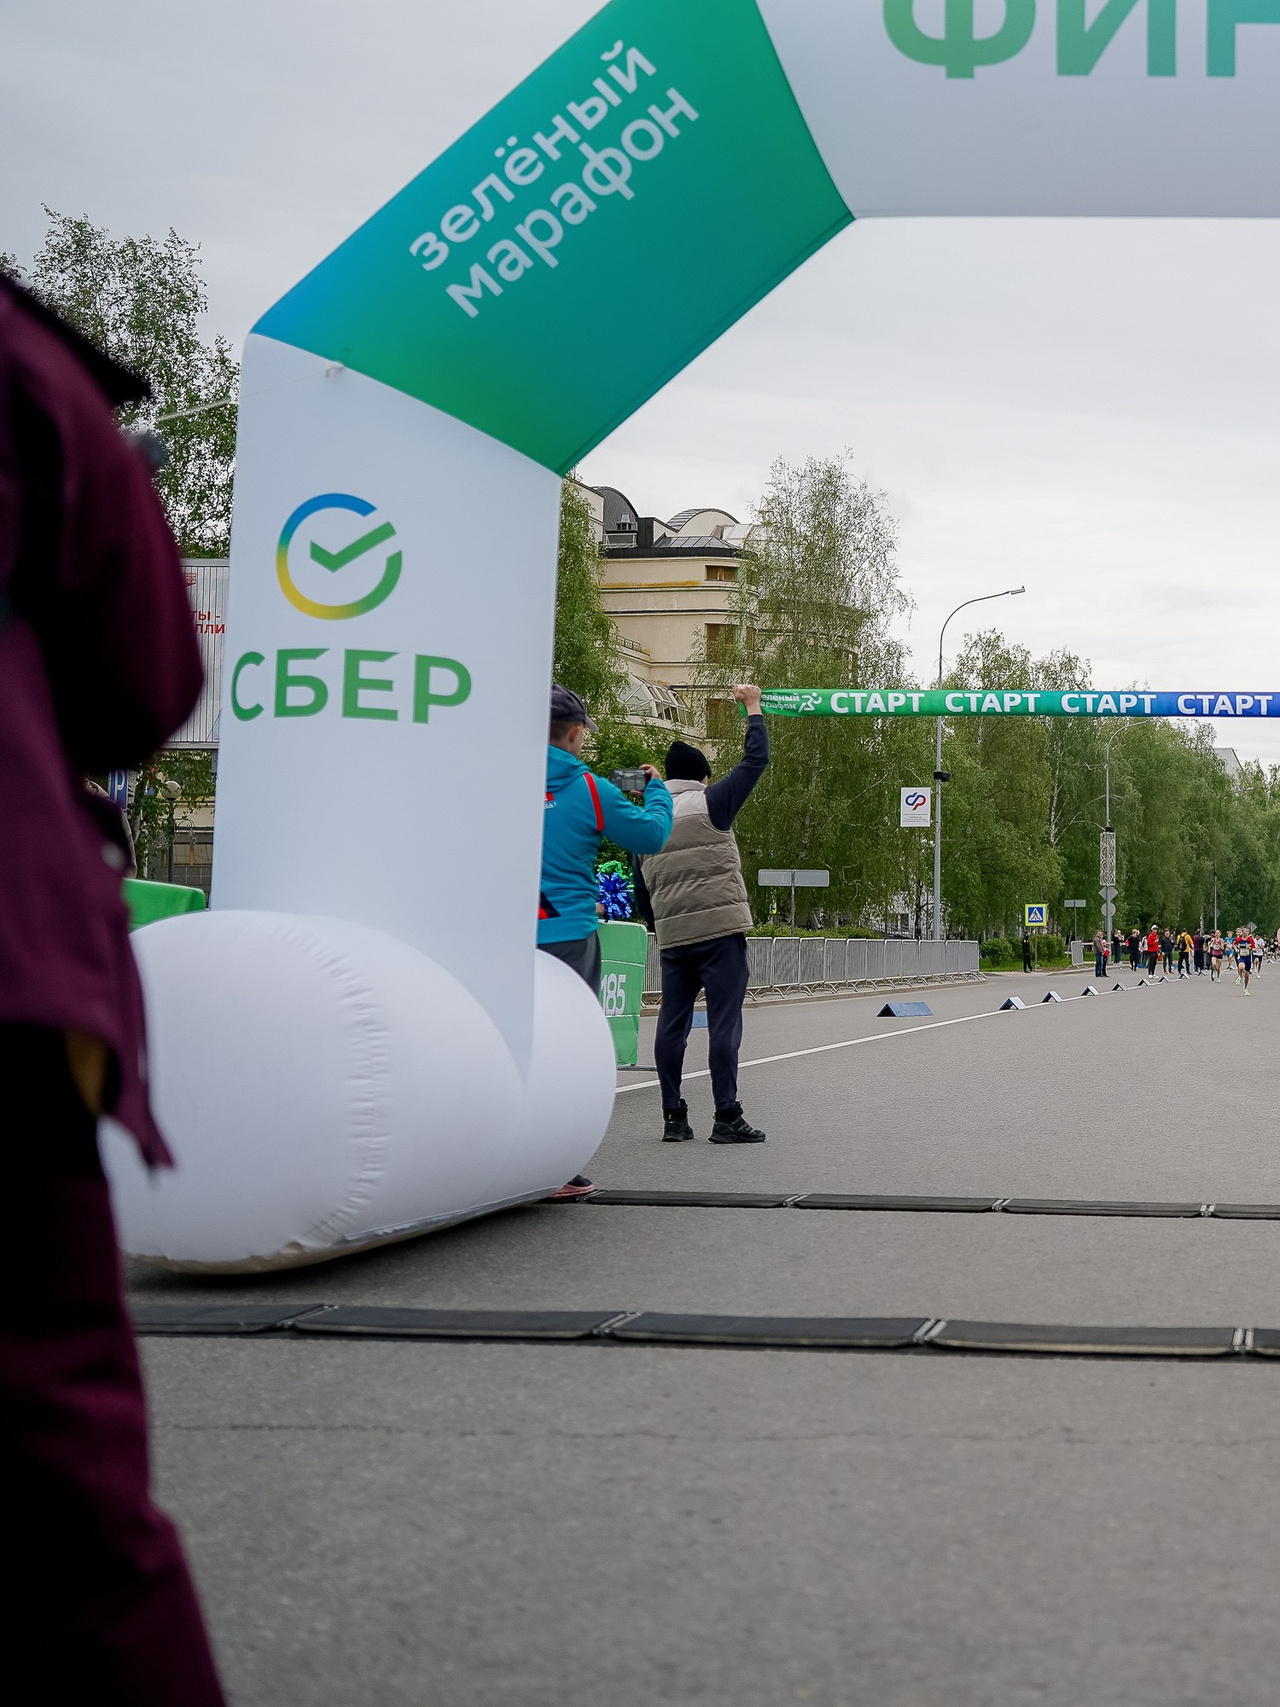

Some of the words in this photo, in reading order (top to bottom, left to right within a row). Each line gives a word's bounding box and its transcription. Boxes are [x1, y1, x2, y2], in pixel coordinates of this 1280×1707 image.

[409, 39, 657, 271] зелёный
[445, 87, 700, 318] марафон
[231, 648, 472, 724] СБЕР
[761, 692, 800, 703] елёный
[830, 692, 924, 713] СТАРТ
[945, 692, 1041, 713] СТАРТ
[1061, 693, 1158, 714] СТАРТ
[1178, 694, 1274, 716] СТАРТ
